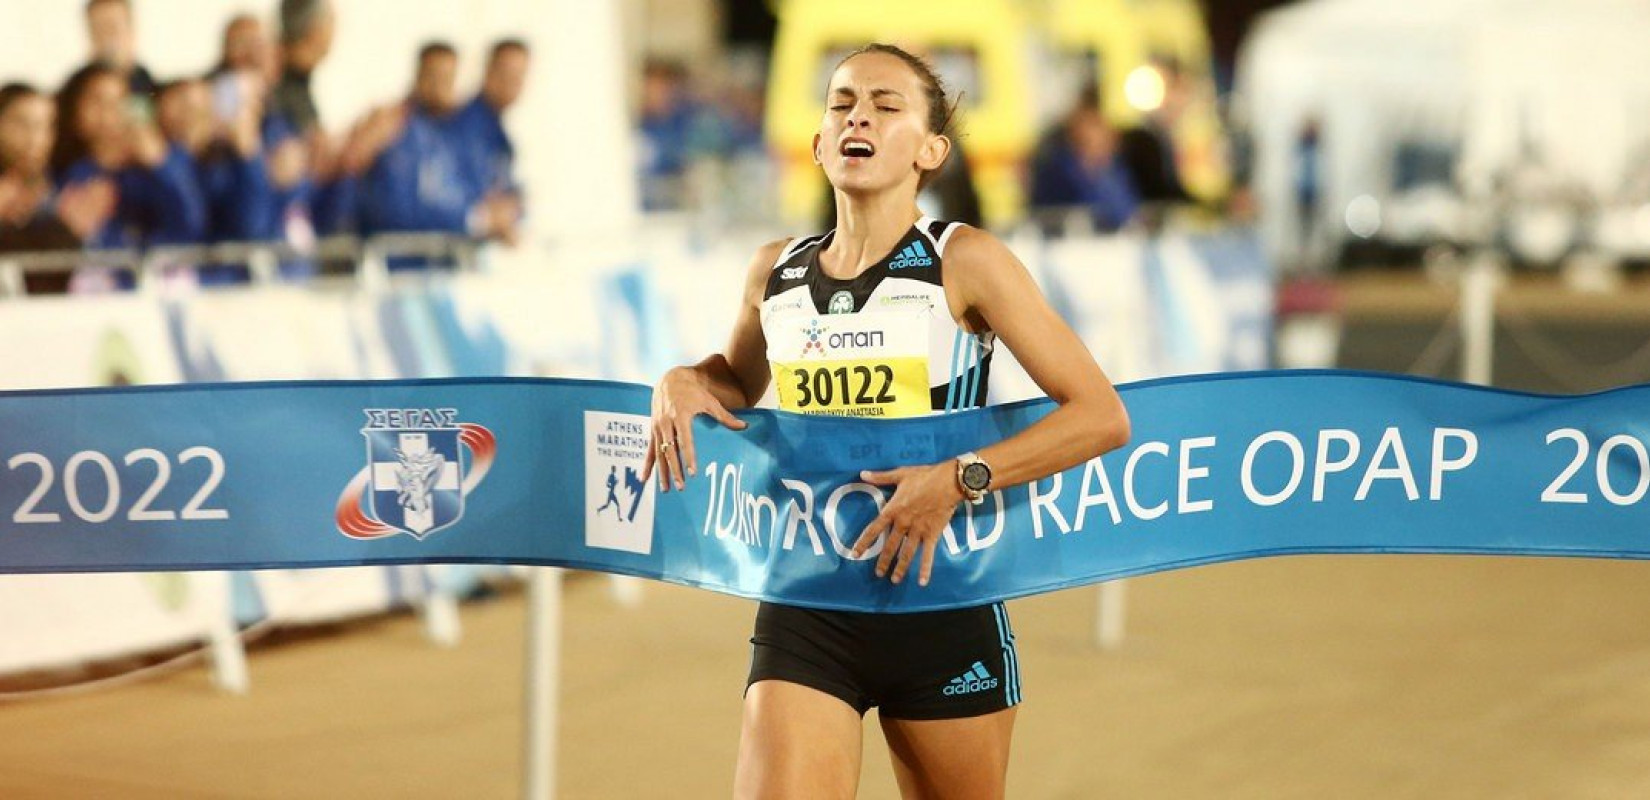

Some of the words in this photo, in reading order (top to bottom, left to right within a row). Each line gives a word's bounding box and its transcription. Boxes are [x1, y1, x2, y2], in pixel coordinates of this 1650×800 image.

[888, 256, 932, 270] adidas
[793, 364, 896, 407] 30122
[363, 408, 458, 429] ΣΕΓΑΣ
[607, 421, 643, 434] ATHENS
[597, 447, 612, 457] THE
[8, 445, 229, 524] 2022
[780, 477, 1006, 562] ROD
[1029, 436, 1217, 539] RACE
[1240, 426, 1479, 507] OPAP
[942, 677, 998, 696] adidas
